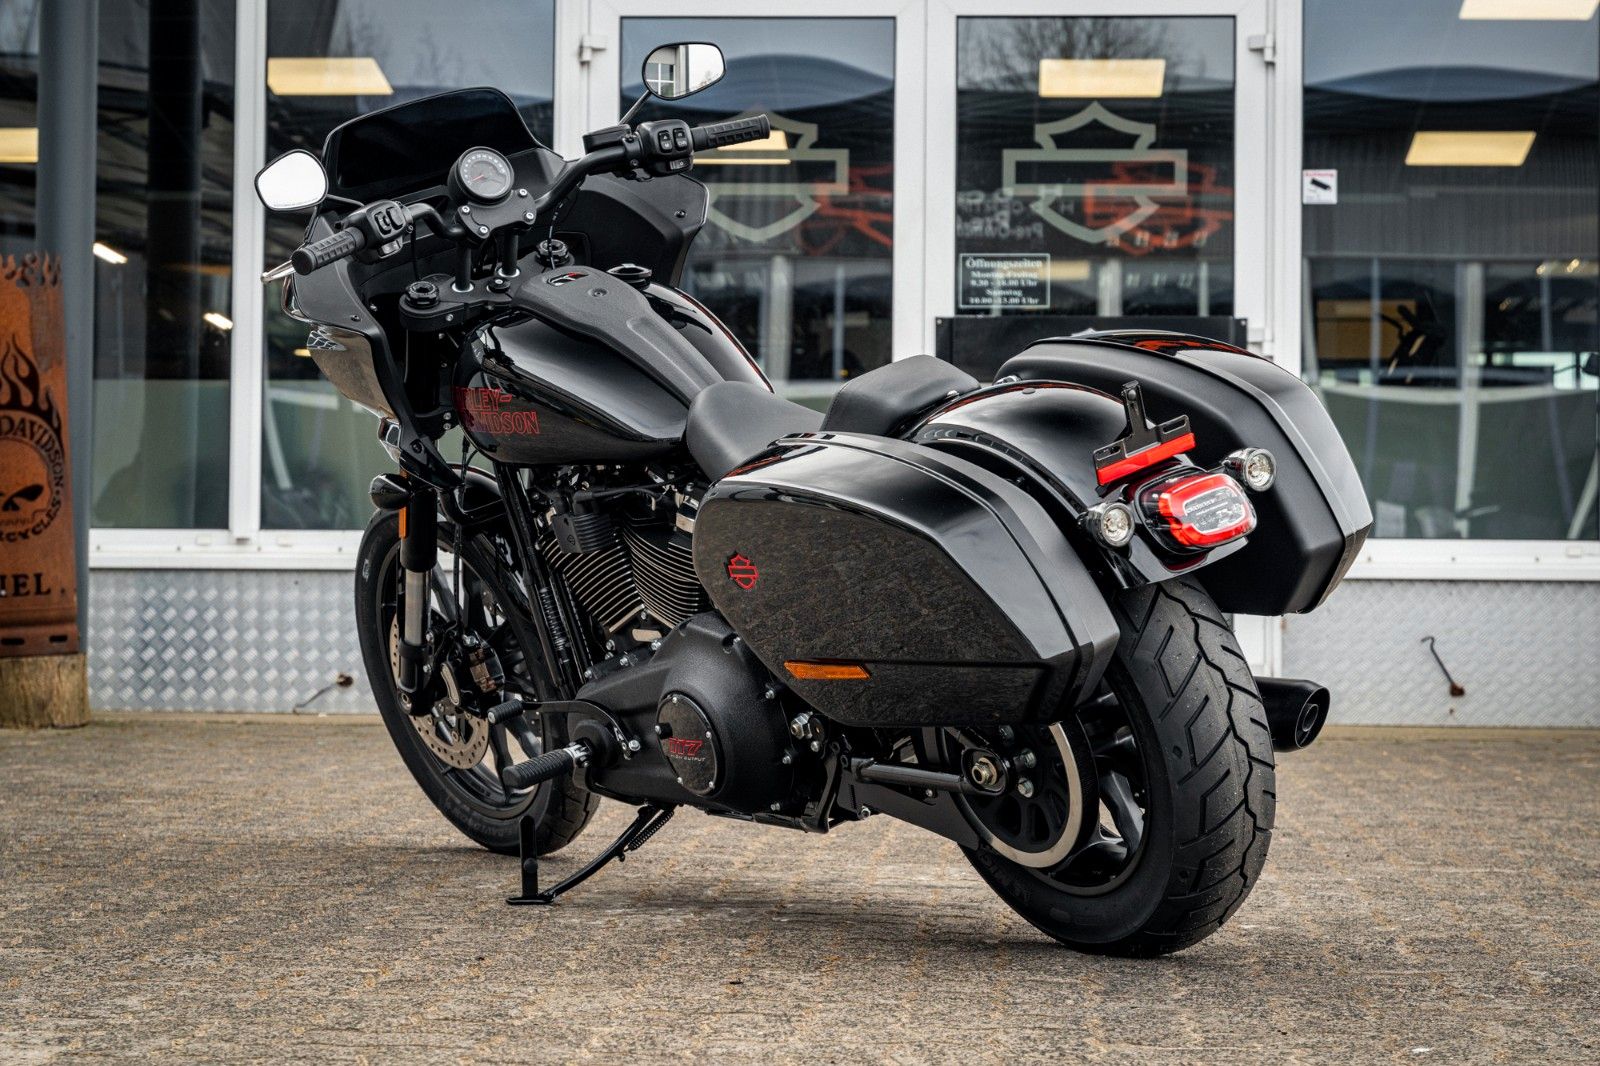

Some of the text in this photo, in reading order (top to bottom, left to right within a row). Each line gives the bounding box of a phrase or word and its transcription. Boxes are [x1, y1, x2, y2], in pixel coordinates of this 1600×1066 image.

[965, 257, 1042, 269] Öffnungszeiten
[0, 415, 65, 488] DAVIDSON
[0, 572, 52, 598] IEL
